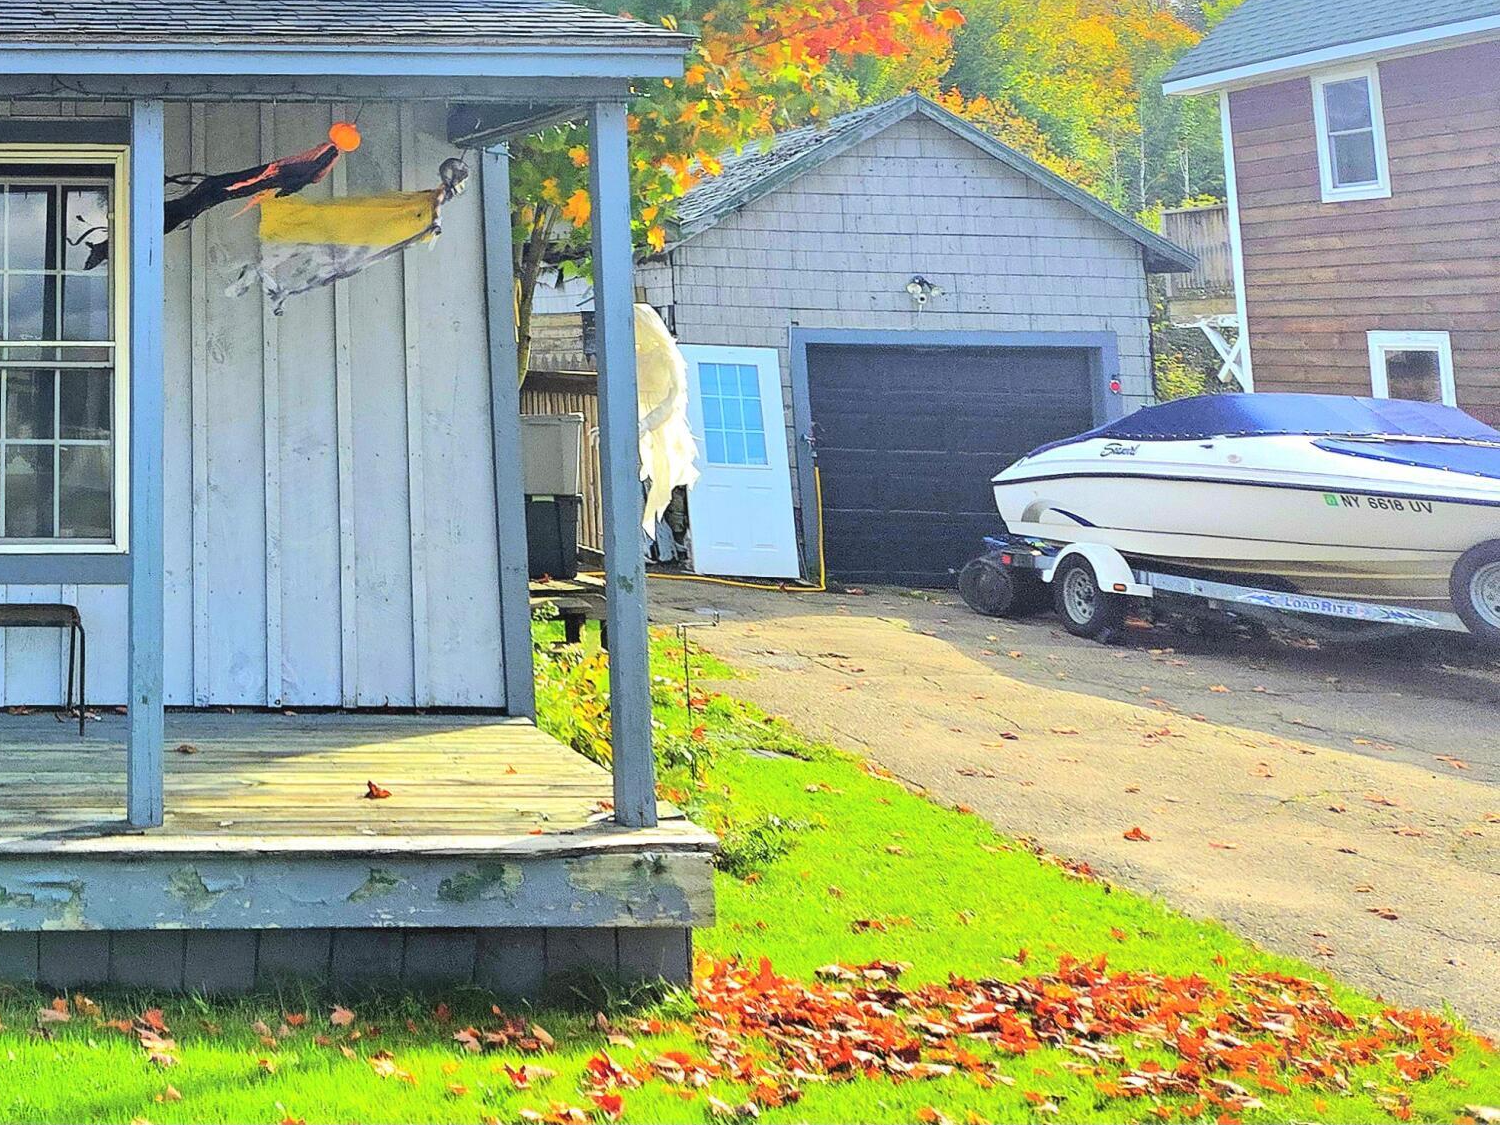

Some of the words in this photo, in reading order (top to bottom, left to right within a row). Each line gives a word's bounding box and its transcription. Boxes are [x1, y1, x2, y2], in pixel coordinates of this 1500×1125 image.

[1340, 495, 1360, 508] NY
[1367, 497, 1404, 511] 6618
[1409, 501, 1433, 514] UV
